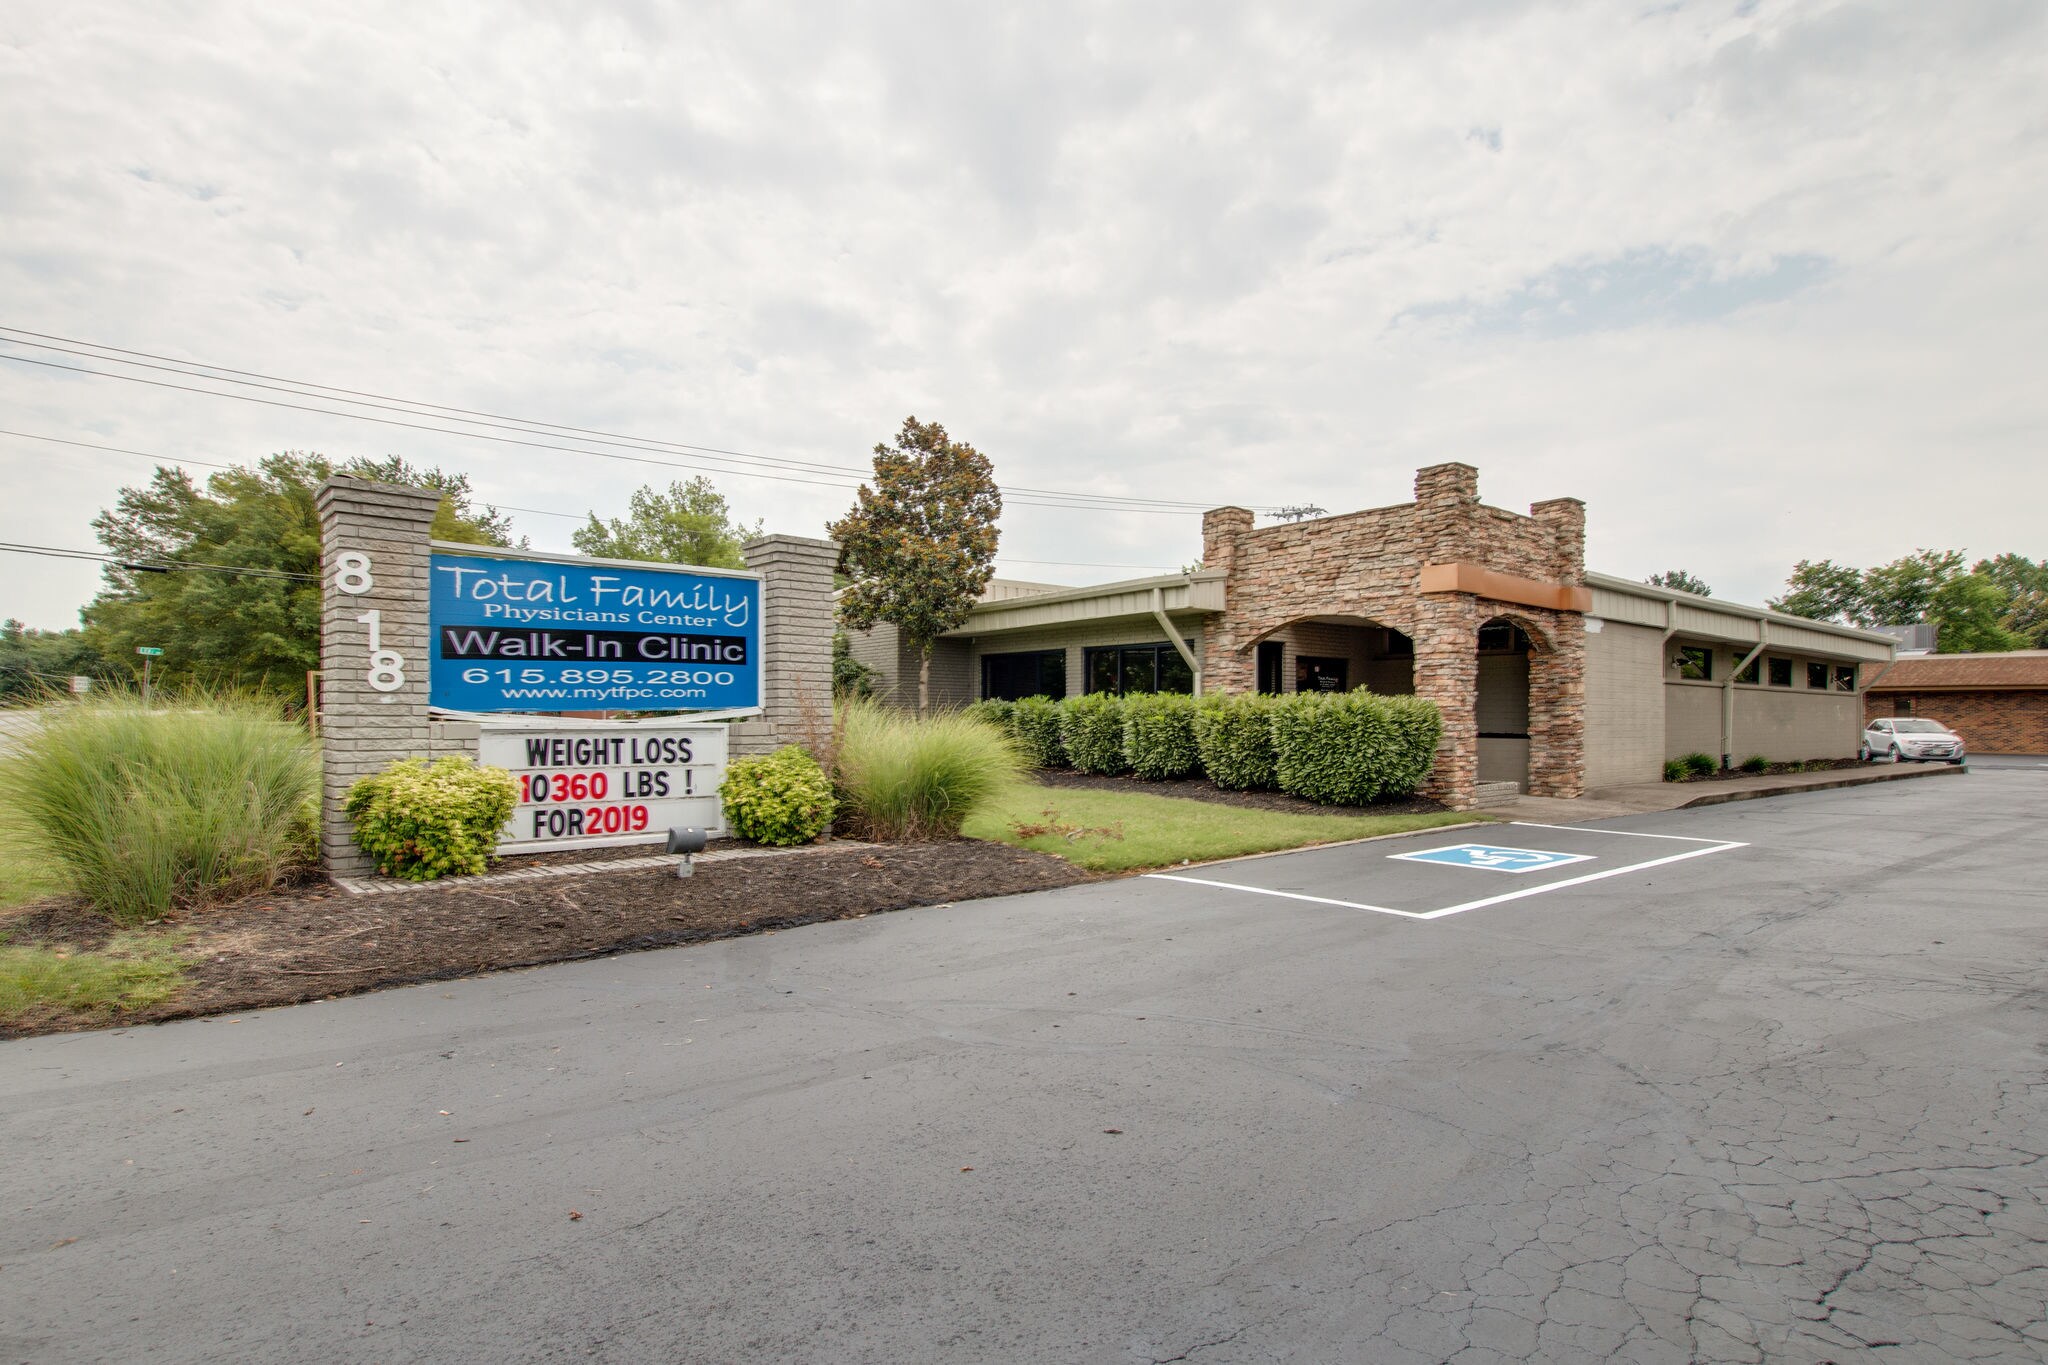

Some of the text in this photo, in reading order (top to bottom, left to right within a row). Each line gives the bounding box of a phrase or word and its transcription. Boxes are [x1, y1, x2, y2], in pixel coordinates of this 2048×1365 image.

[436, 566, 749, 628] Total Family
[483, 603, 718, 627] Physicians Center
[446, 630, 744, 662] Walk-In Clinic
[462, 668, 735, 686] 615.895.2800
[501, 686, 706, 701] www.mytfpc.com
[525, 737, 693, 767] WEIGHT LOSS
[519, 772, 609, 803] 10360
[623, 770, 670, 798] LBS
